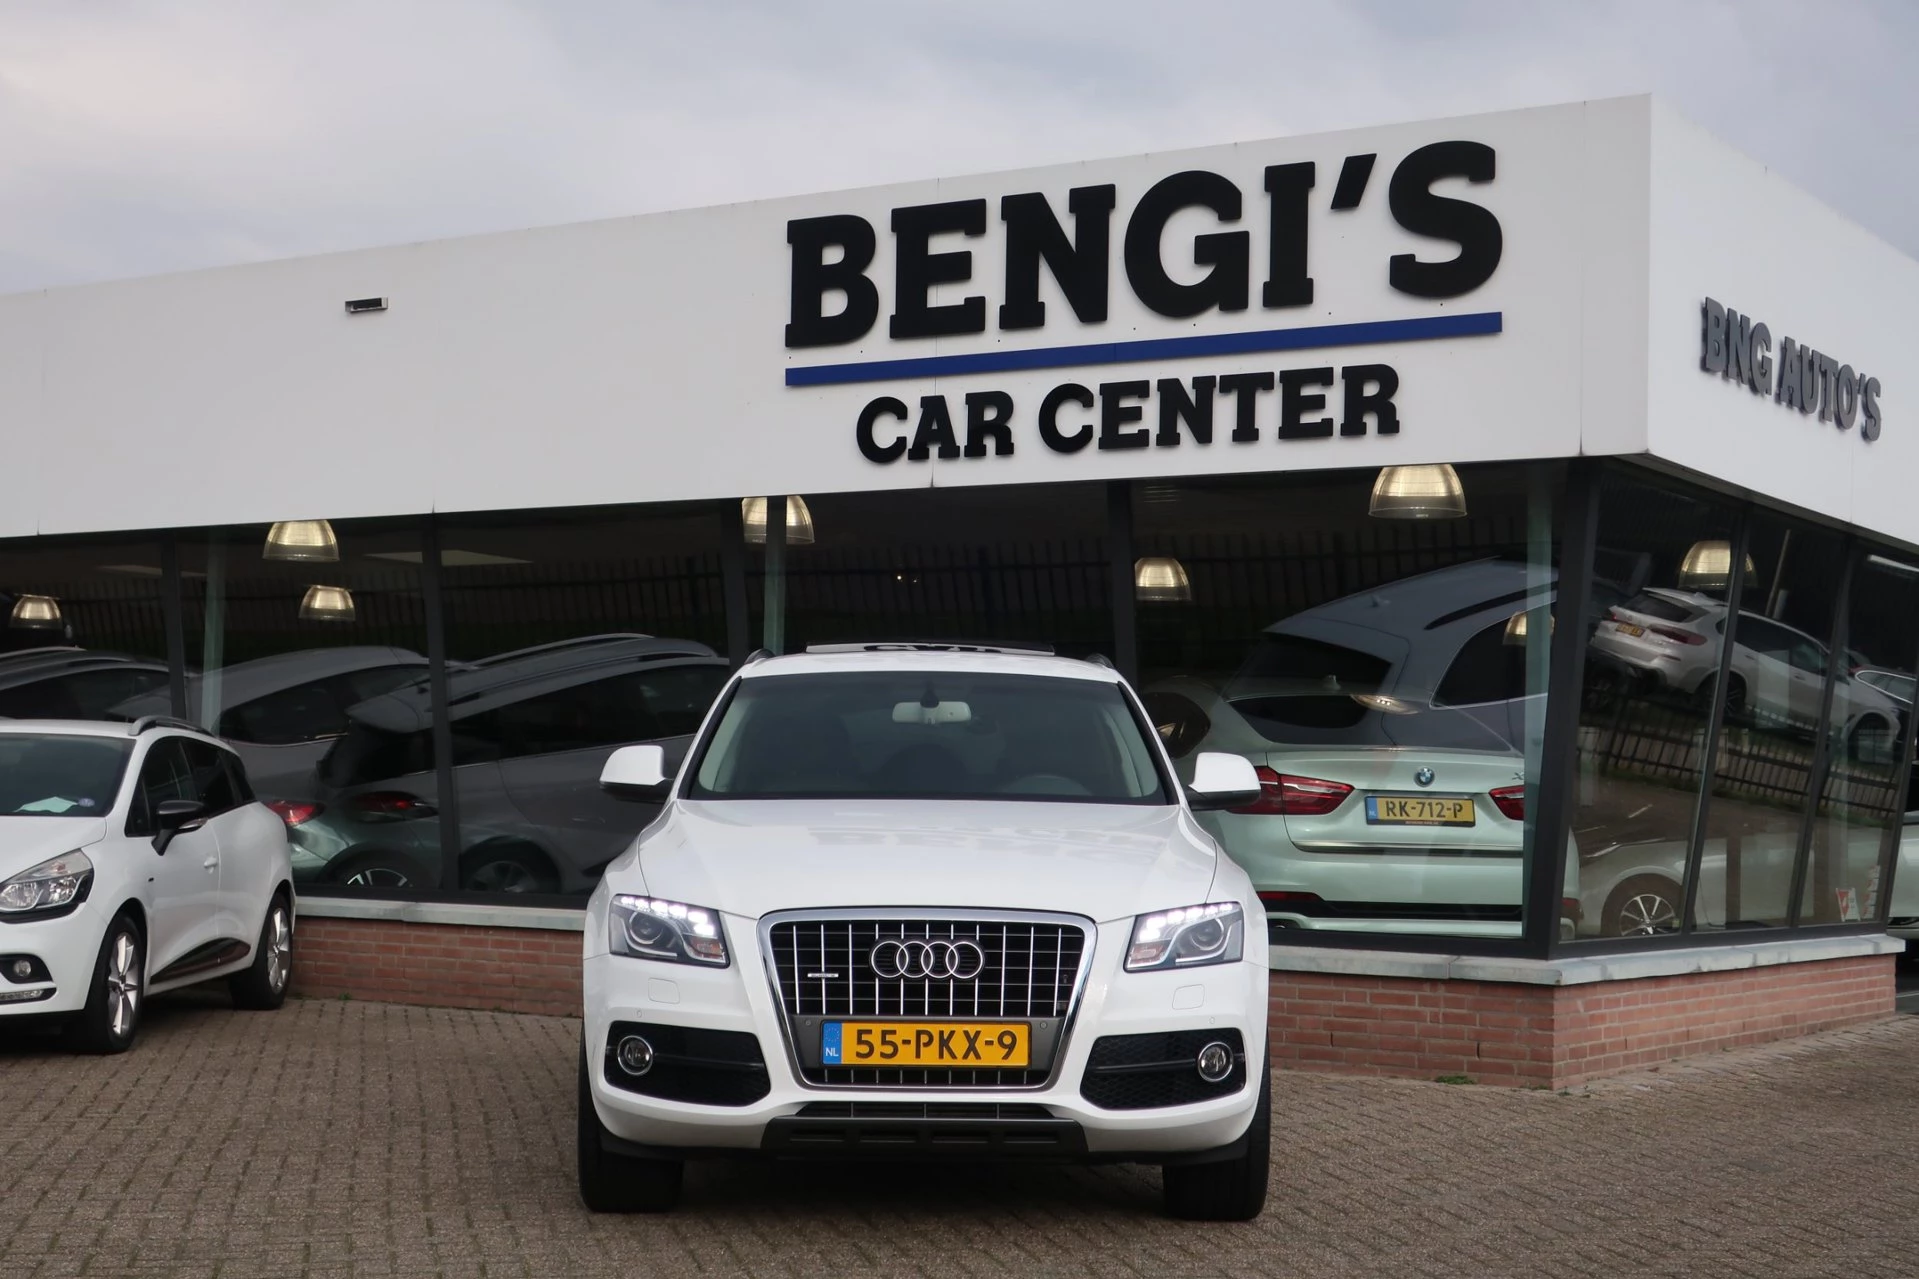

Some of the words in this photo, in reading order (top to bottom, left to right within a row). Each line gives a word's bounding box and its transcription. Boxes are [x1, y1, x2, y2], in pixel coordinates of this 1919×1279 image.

[785, 140, 1503, 348] BENGI'S
[1703, 296, 1772, 395] BNG
[1777, 336, 1882, 441] AUTO'S
[856, 390, 1015, 464] CAR
[1038, 363, 1400, 453] CENTER
[1385, 800, 1463, 818] RK-712-P
[825, 1047, 839, 1057] NL
[855, 1029, 1017, 1060] 55-PKX-9
